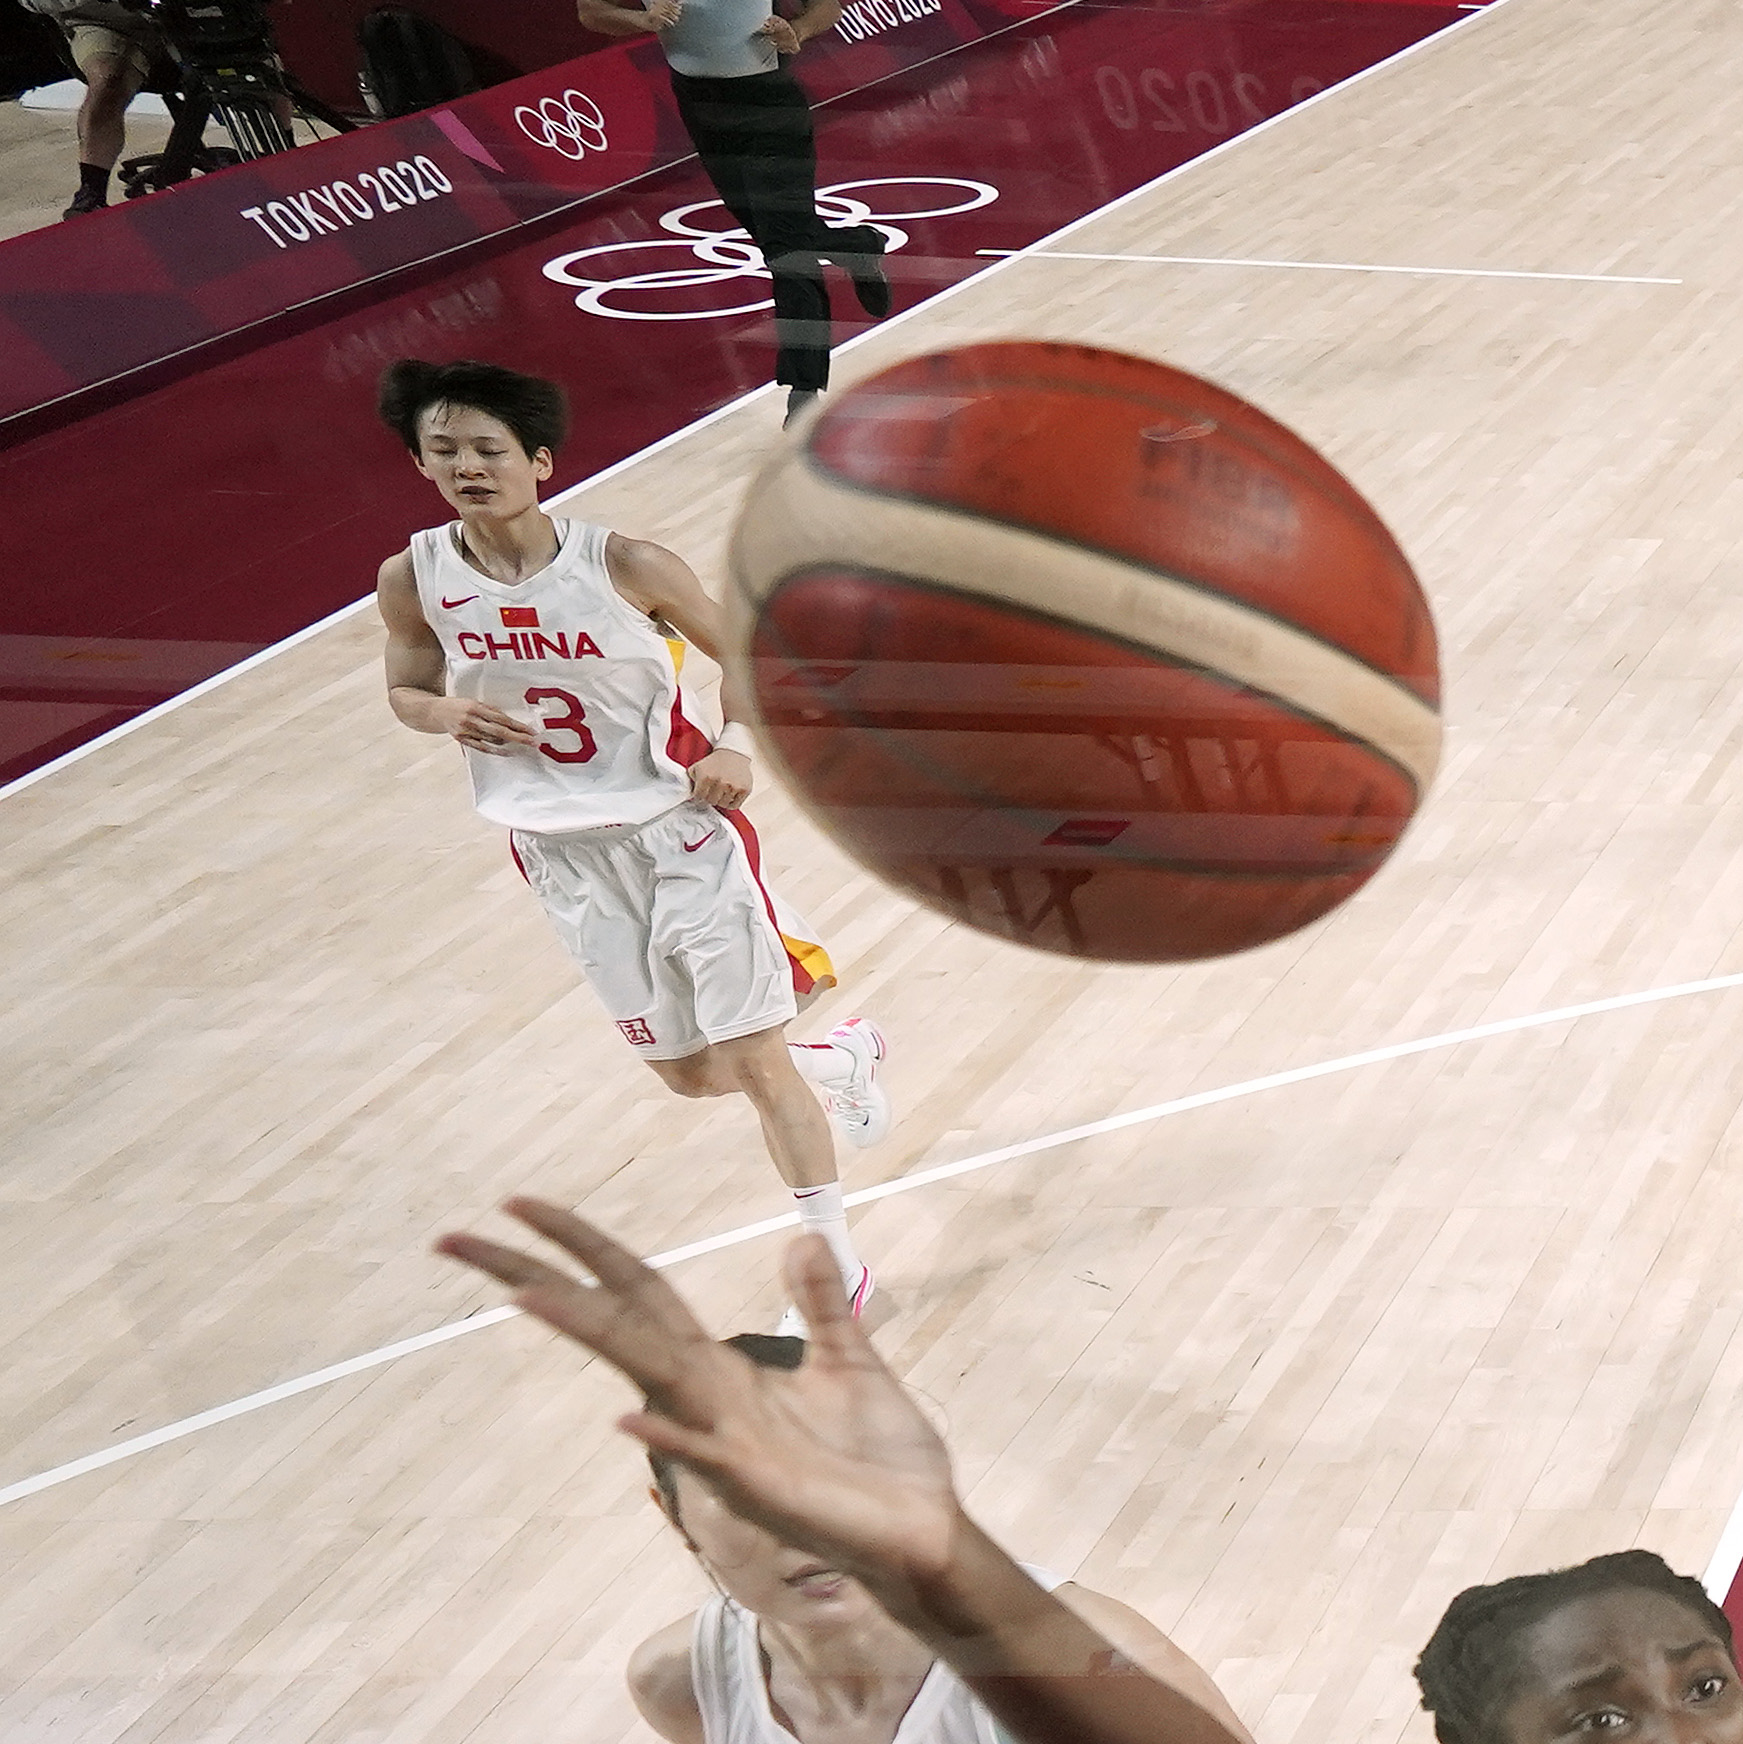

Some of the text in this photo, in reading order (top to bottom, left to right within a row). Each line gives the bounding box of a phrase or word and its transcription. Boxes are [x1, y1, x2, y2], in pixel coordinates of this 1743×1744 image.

[240, 154, 453, 249] TOKYO 2020
[457, 631, 606, 660] CHINA
[523, 686, 599, 764] 3
[614, 1017, 657, 1045] 国
